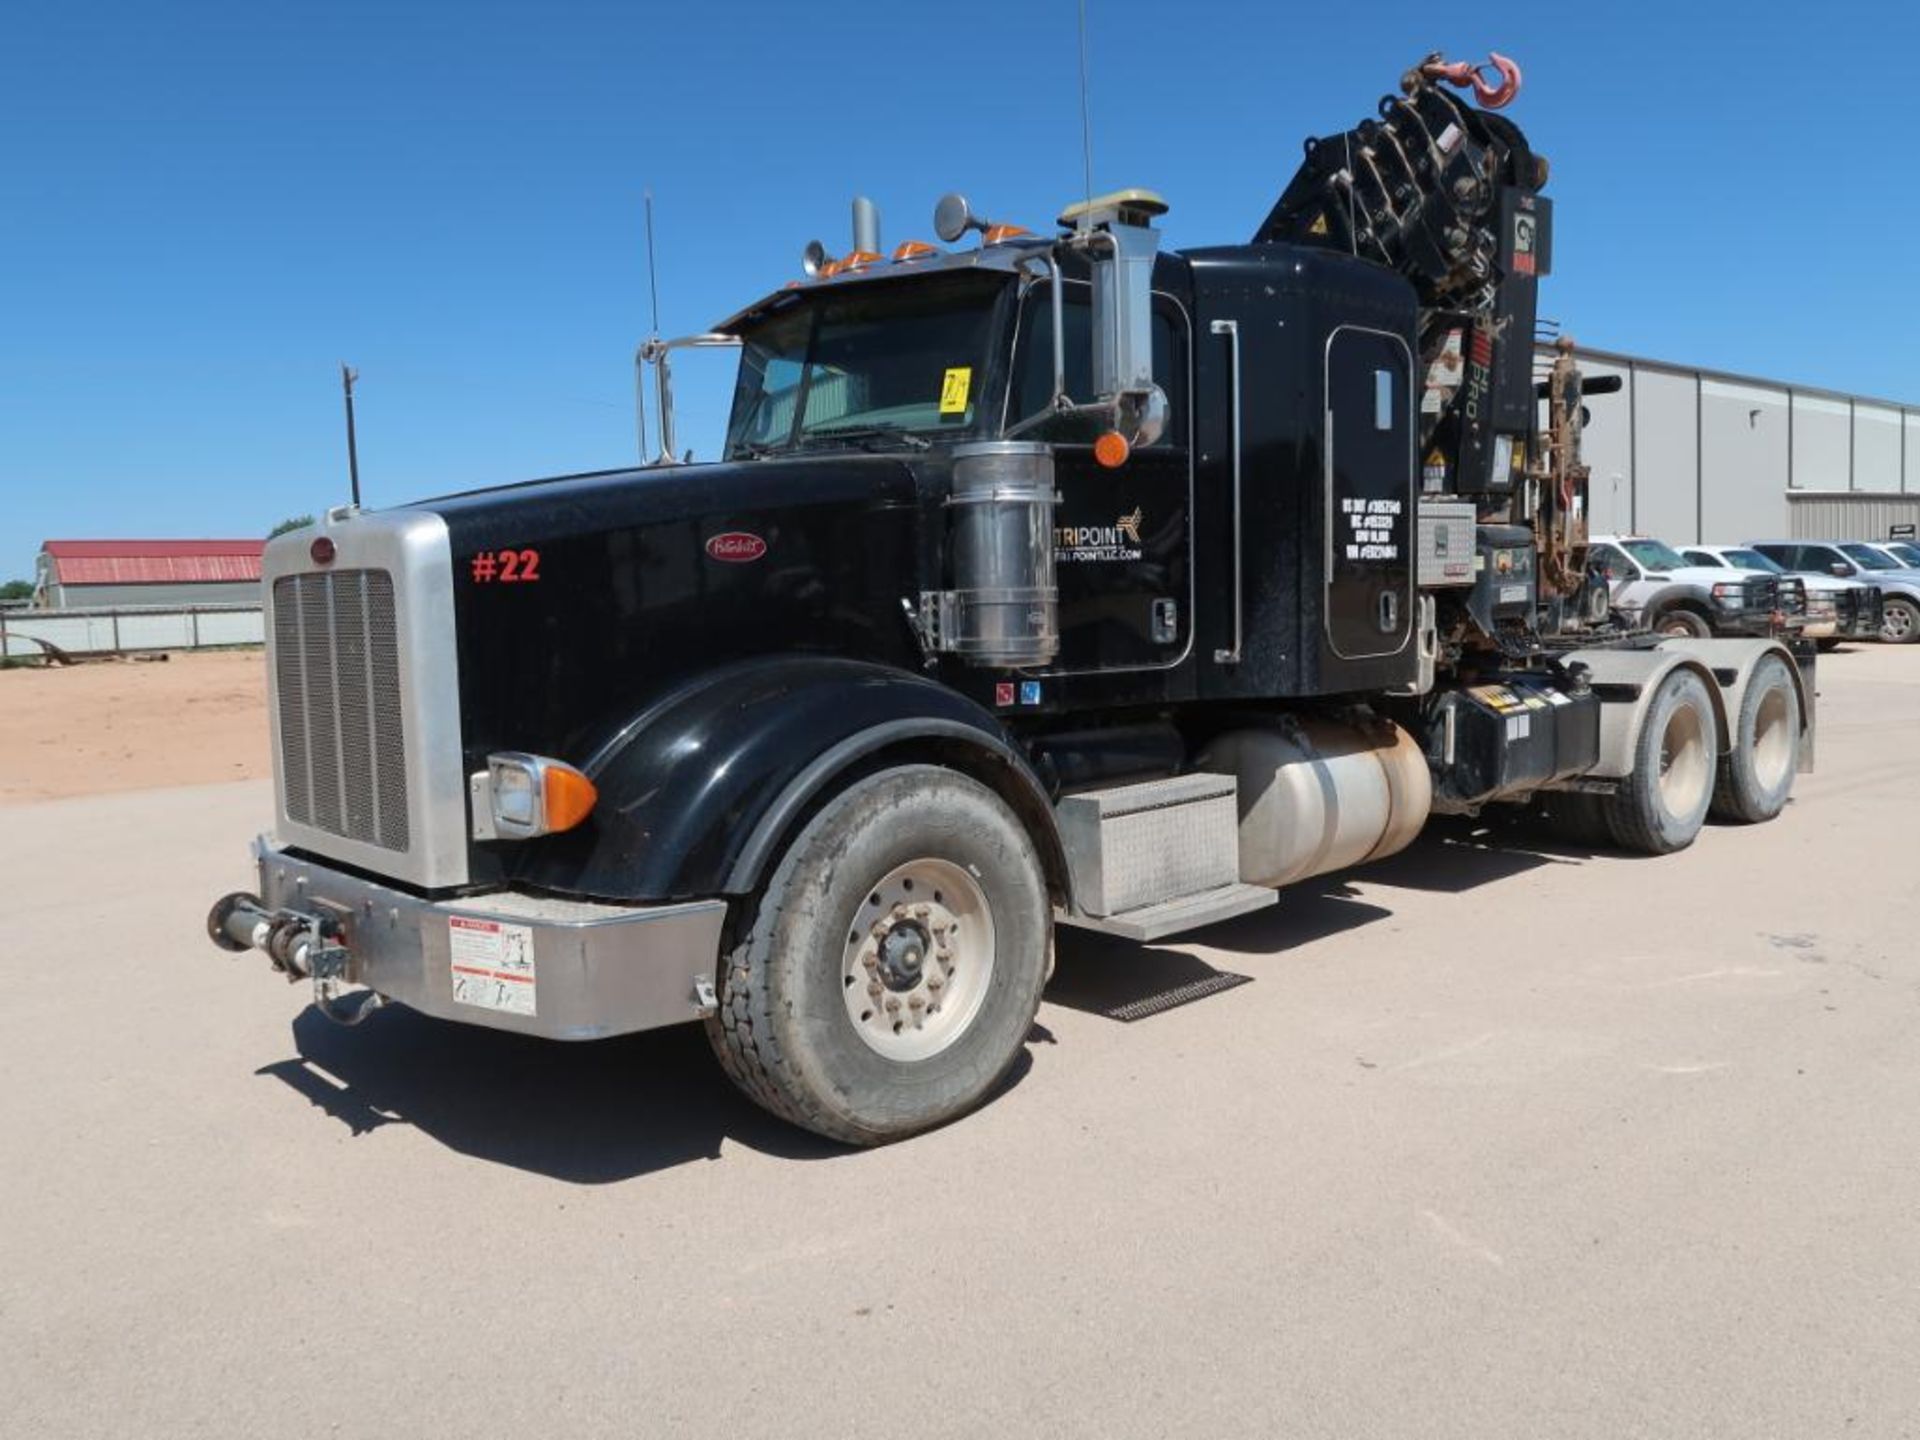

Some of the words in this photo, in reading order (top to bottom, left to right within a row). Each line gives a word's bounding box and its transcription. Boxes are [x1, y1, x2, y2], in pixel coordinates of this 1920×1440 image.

[1466, 360, 1480, 418] PRO
[1053, 526, 1125, 546] TRIPOINT
[471, 549, 540, 582] #22
